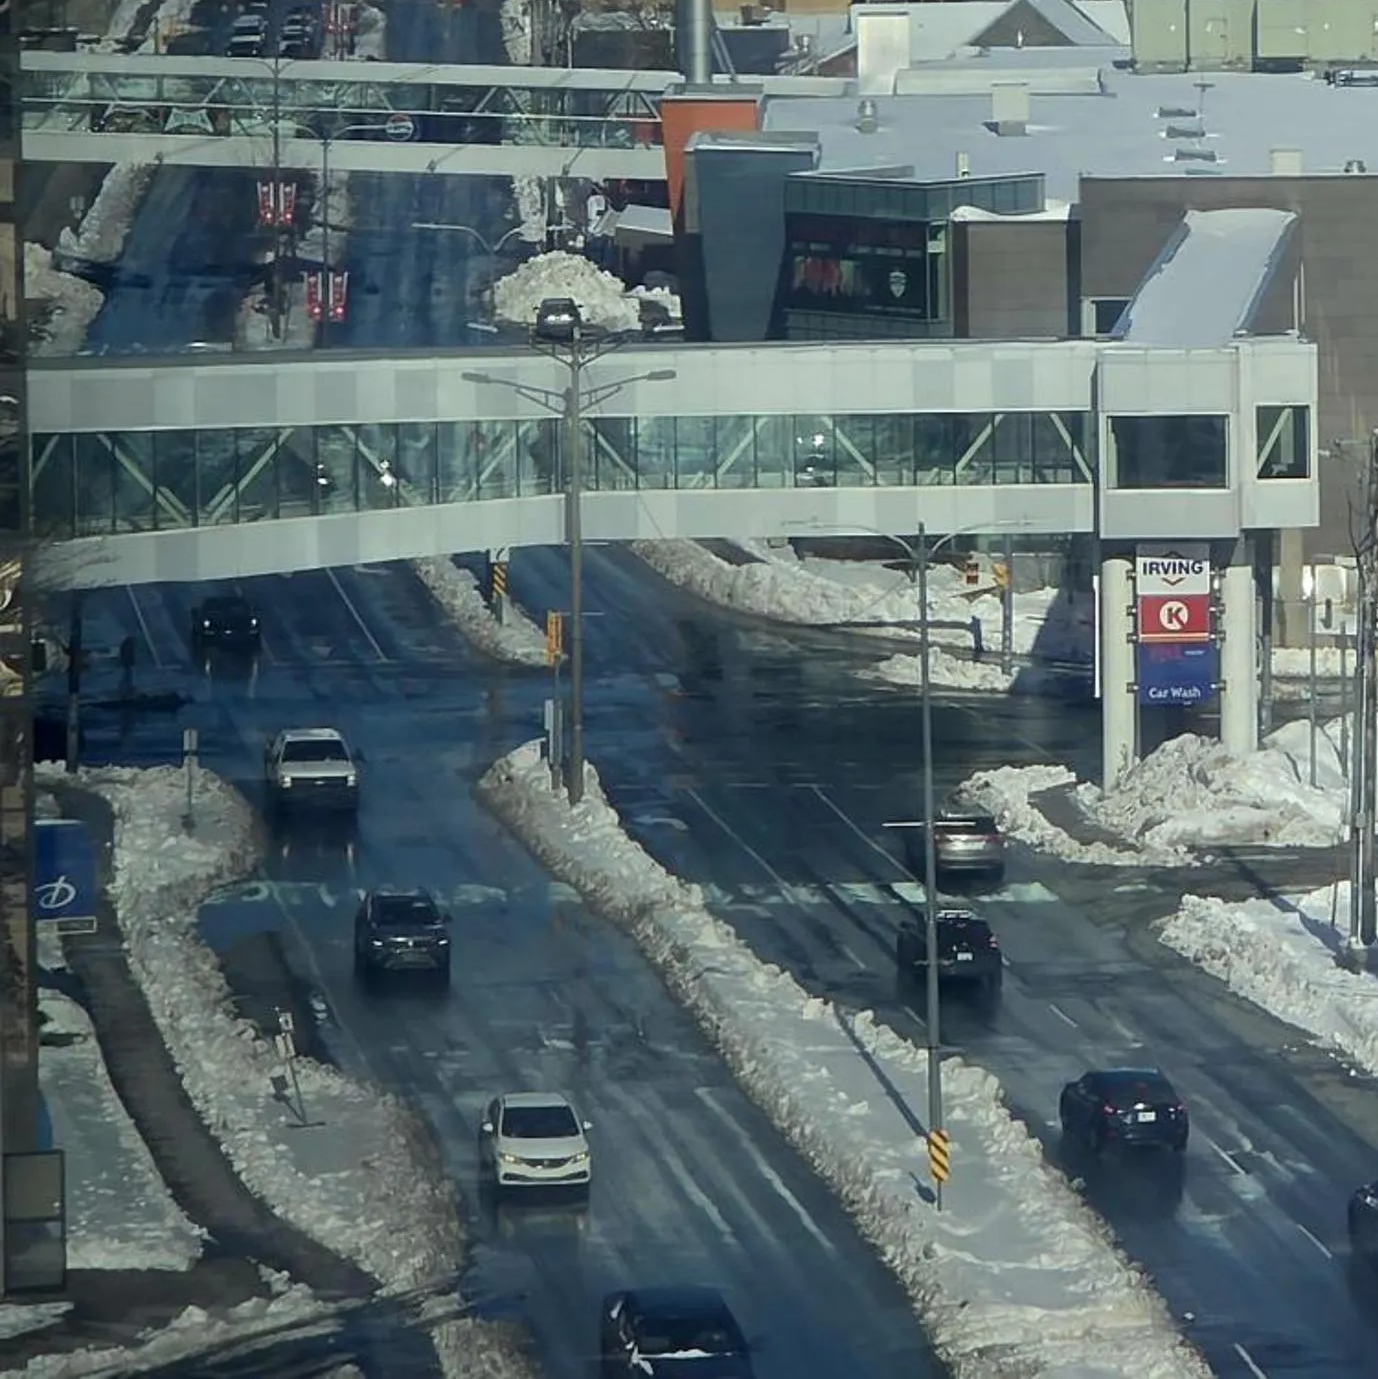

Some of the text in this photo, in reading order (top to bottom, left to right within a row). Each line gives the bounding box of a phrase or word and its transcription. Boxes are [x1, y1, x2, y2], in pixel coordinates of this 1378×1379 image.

[1142, 561, 1205, 576] IRVING
[1164, 605, 1187, 631] K
[1148, 685, 1201, 699] Car Wash
